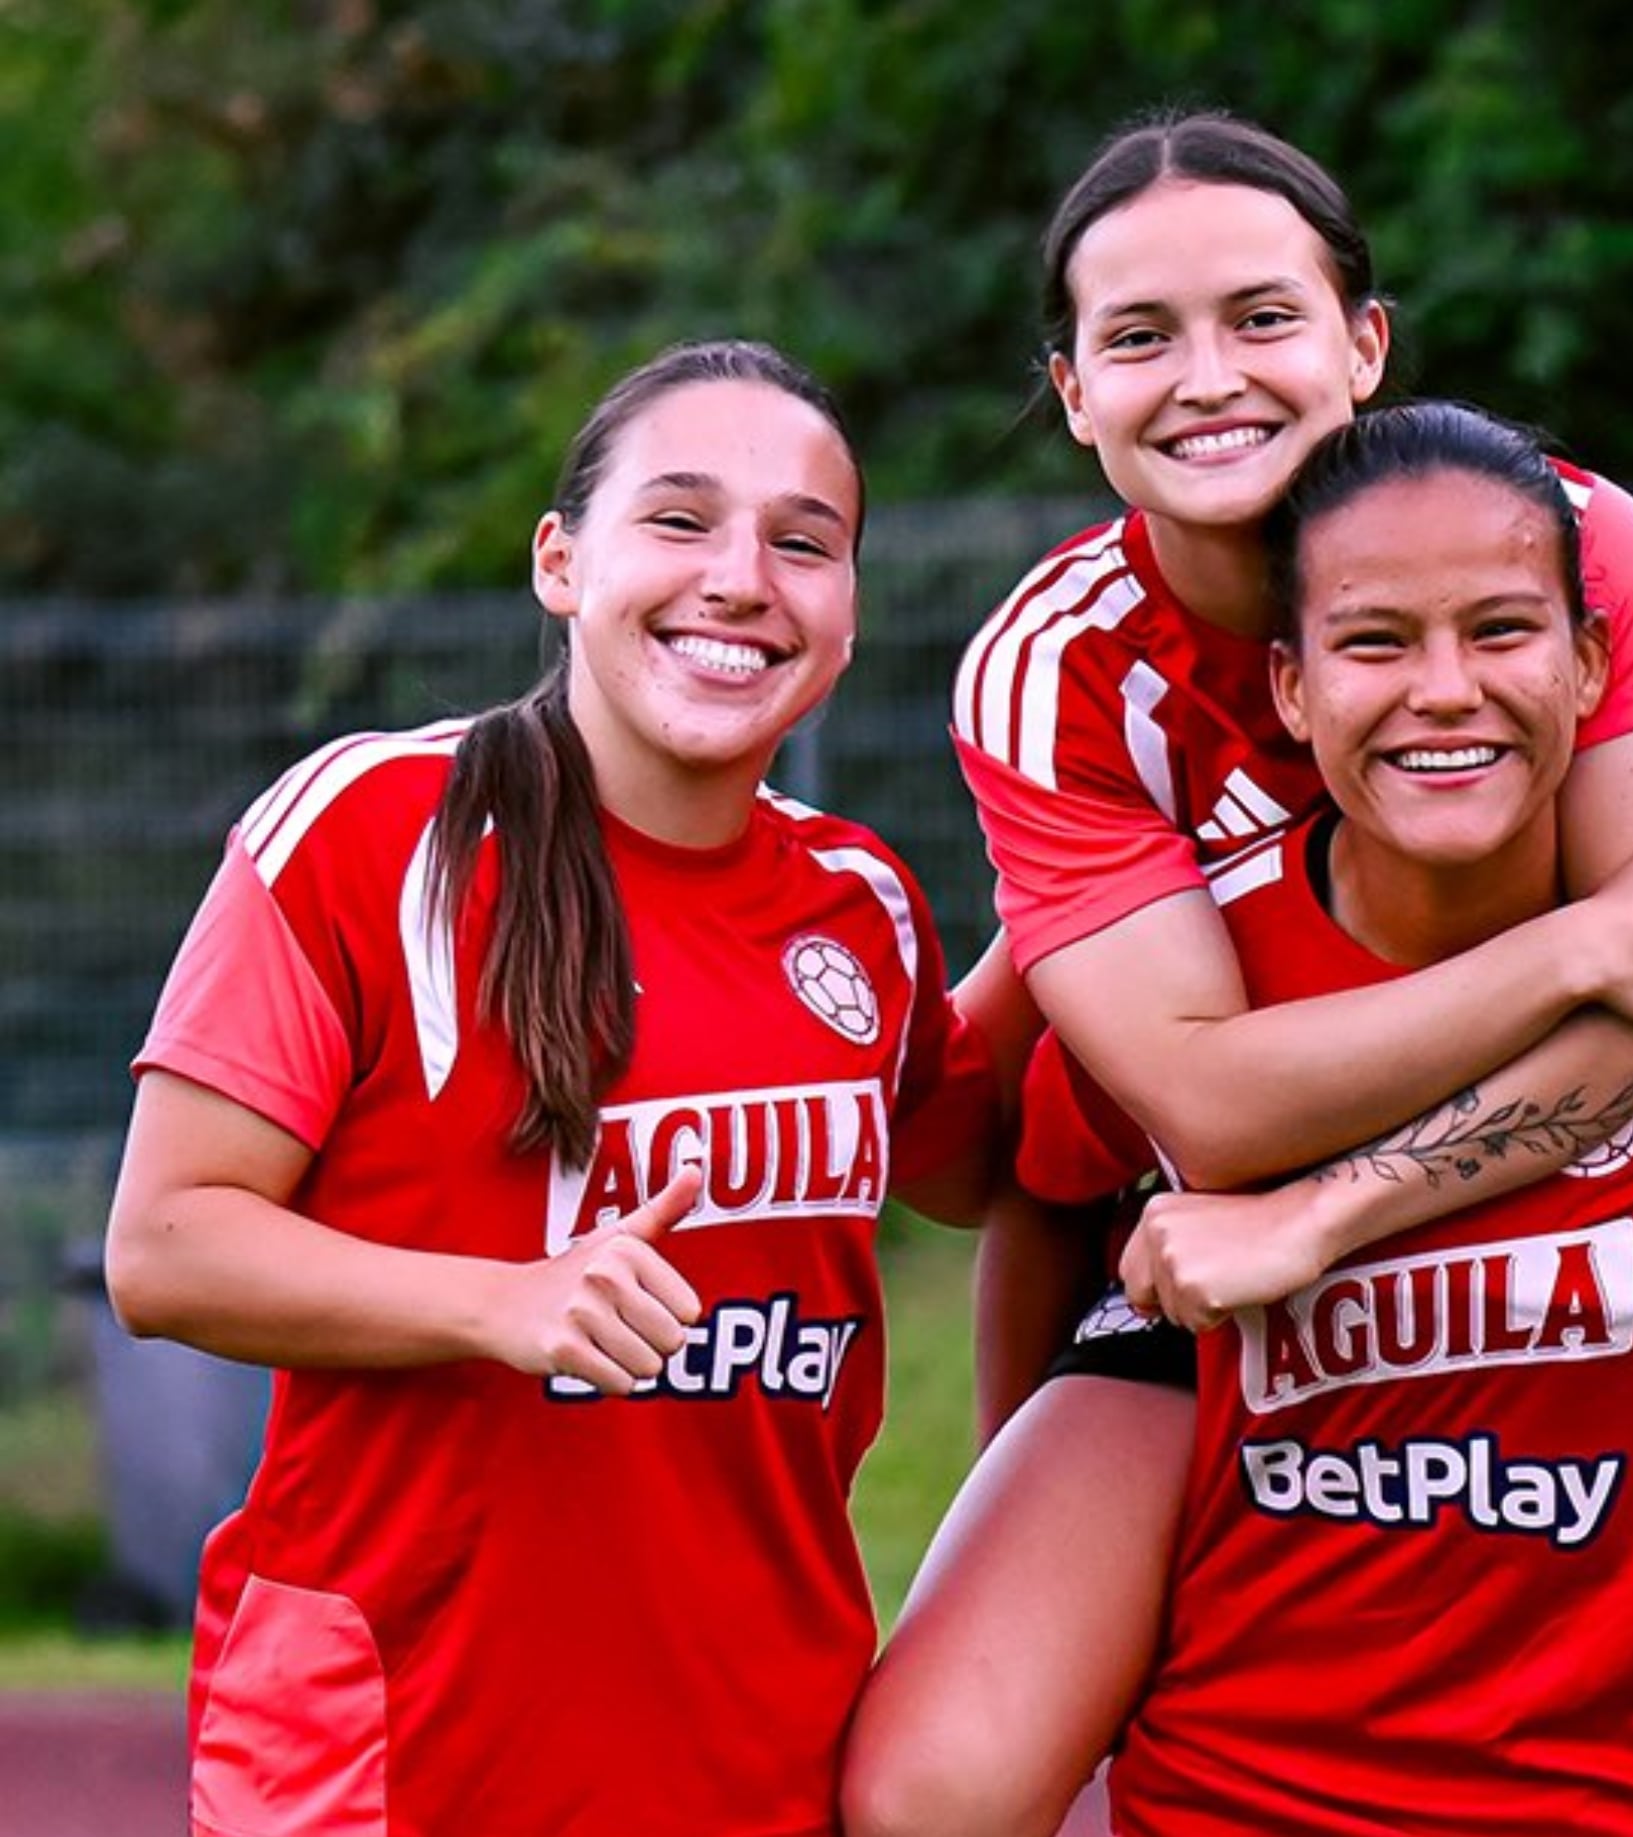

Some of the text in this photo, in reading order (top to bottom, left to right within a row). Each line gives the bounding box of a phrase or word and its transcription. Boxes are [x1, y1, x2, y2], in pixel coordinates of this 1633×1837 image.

[568, 1092, 883, 1239] AGUILA
[549, 1298, 858, 1410] tPlay
[1263, 1240, 1614, 1404] AGUILA
[1242, 1438, 1620, 1544] BetPlay
